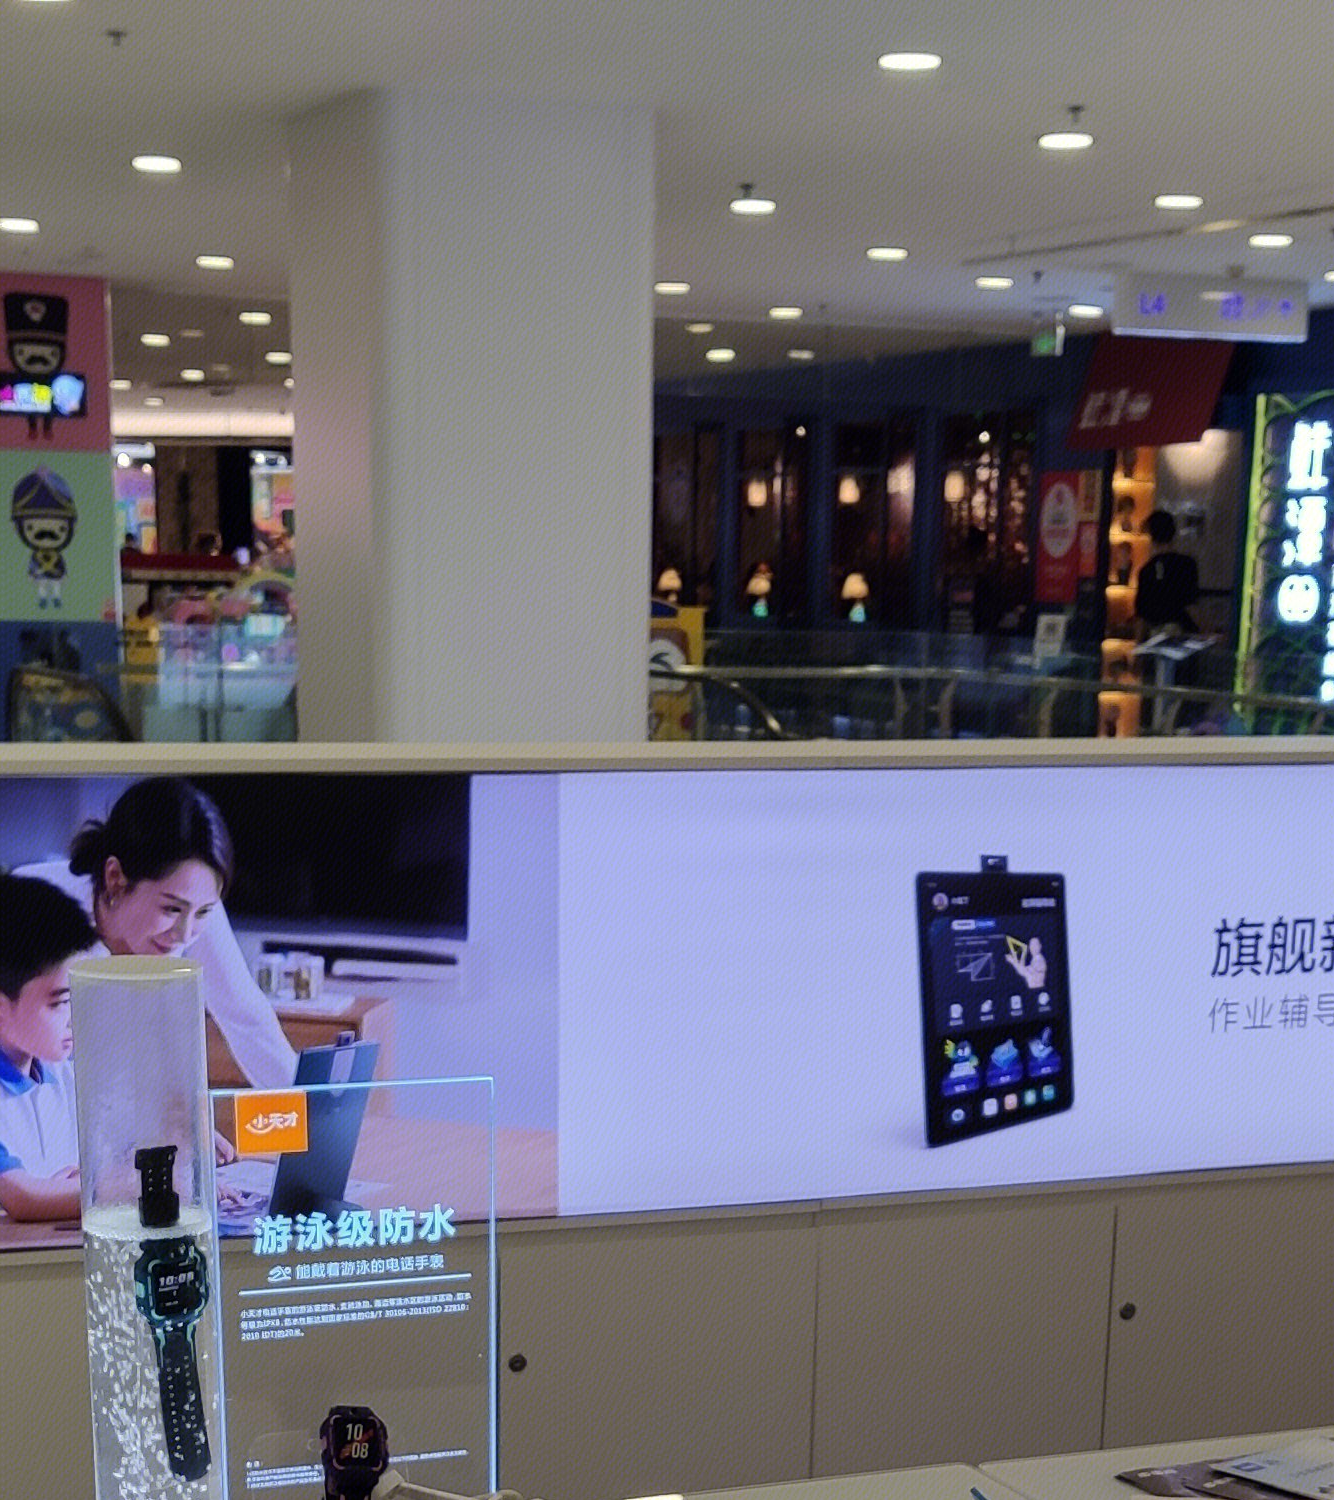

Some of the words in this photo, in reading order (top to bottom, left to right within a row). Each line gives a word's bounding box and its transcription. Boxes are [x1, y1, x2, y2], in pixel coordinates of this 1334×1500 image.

[246, 1111, 299, 1134] 小天才
[253, 1203, 456, 1255] 游泳级防水
[295, 1254, 445, 1280] 能戴着游泳的电话手表
[346, 1424, 364, 1441] 10
[352, 1442, 369, 1459] 08
